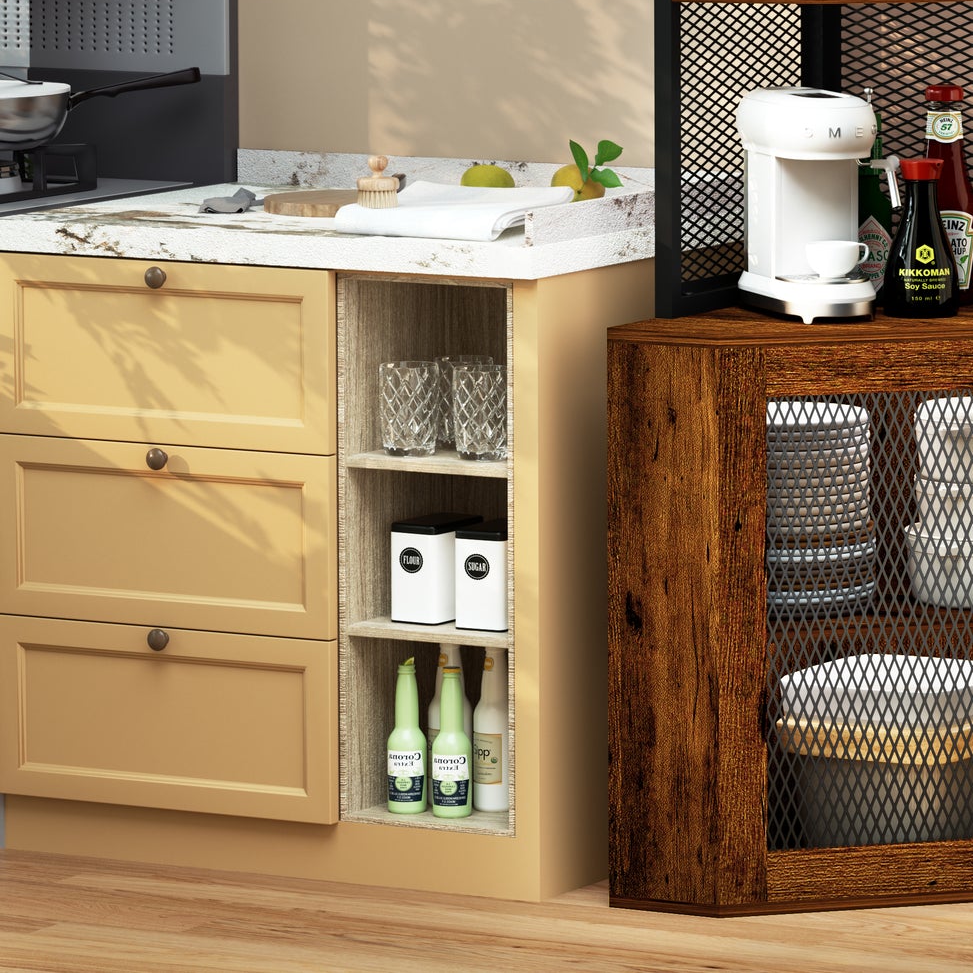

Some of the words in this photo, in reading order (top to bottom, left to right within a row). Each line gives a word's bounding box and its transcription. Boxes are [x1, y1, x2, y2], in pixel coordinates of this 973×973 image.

[940, 123, 953, 131] 57
[942, 220, 966, 232] EINZ
[898, 268, 950, 277] KIKKOMAN
[904, 283, 920, 291] Soy
[403, 555, 420, 566] FLOUR
[468, 562, 487, 572] SUGAR
